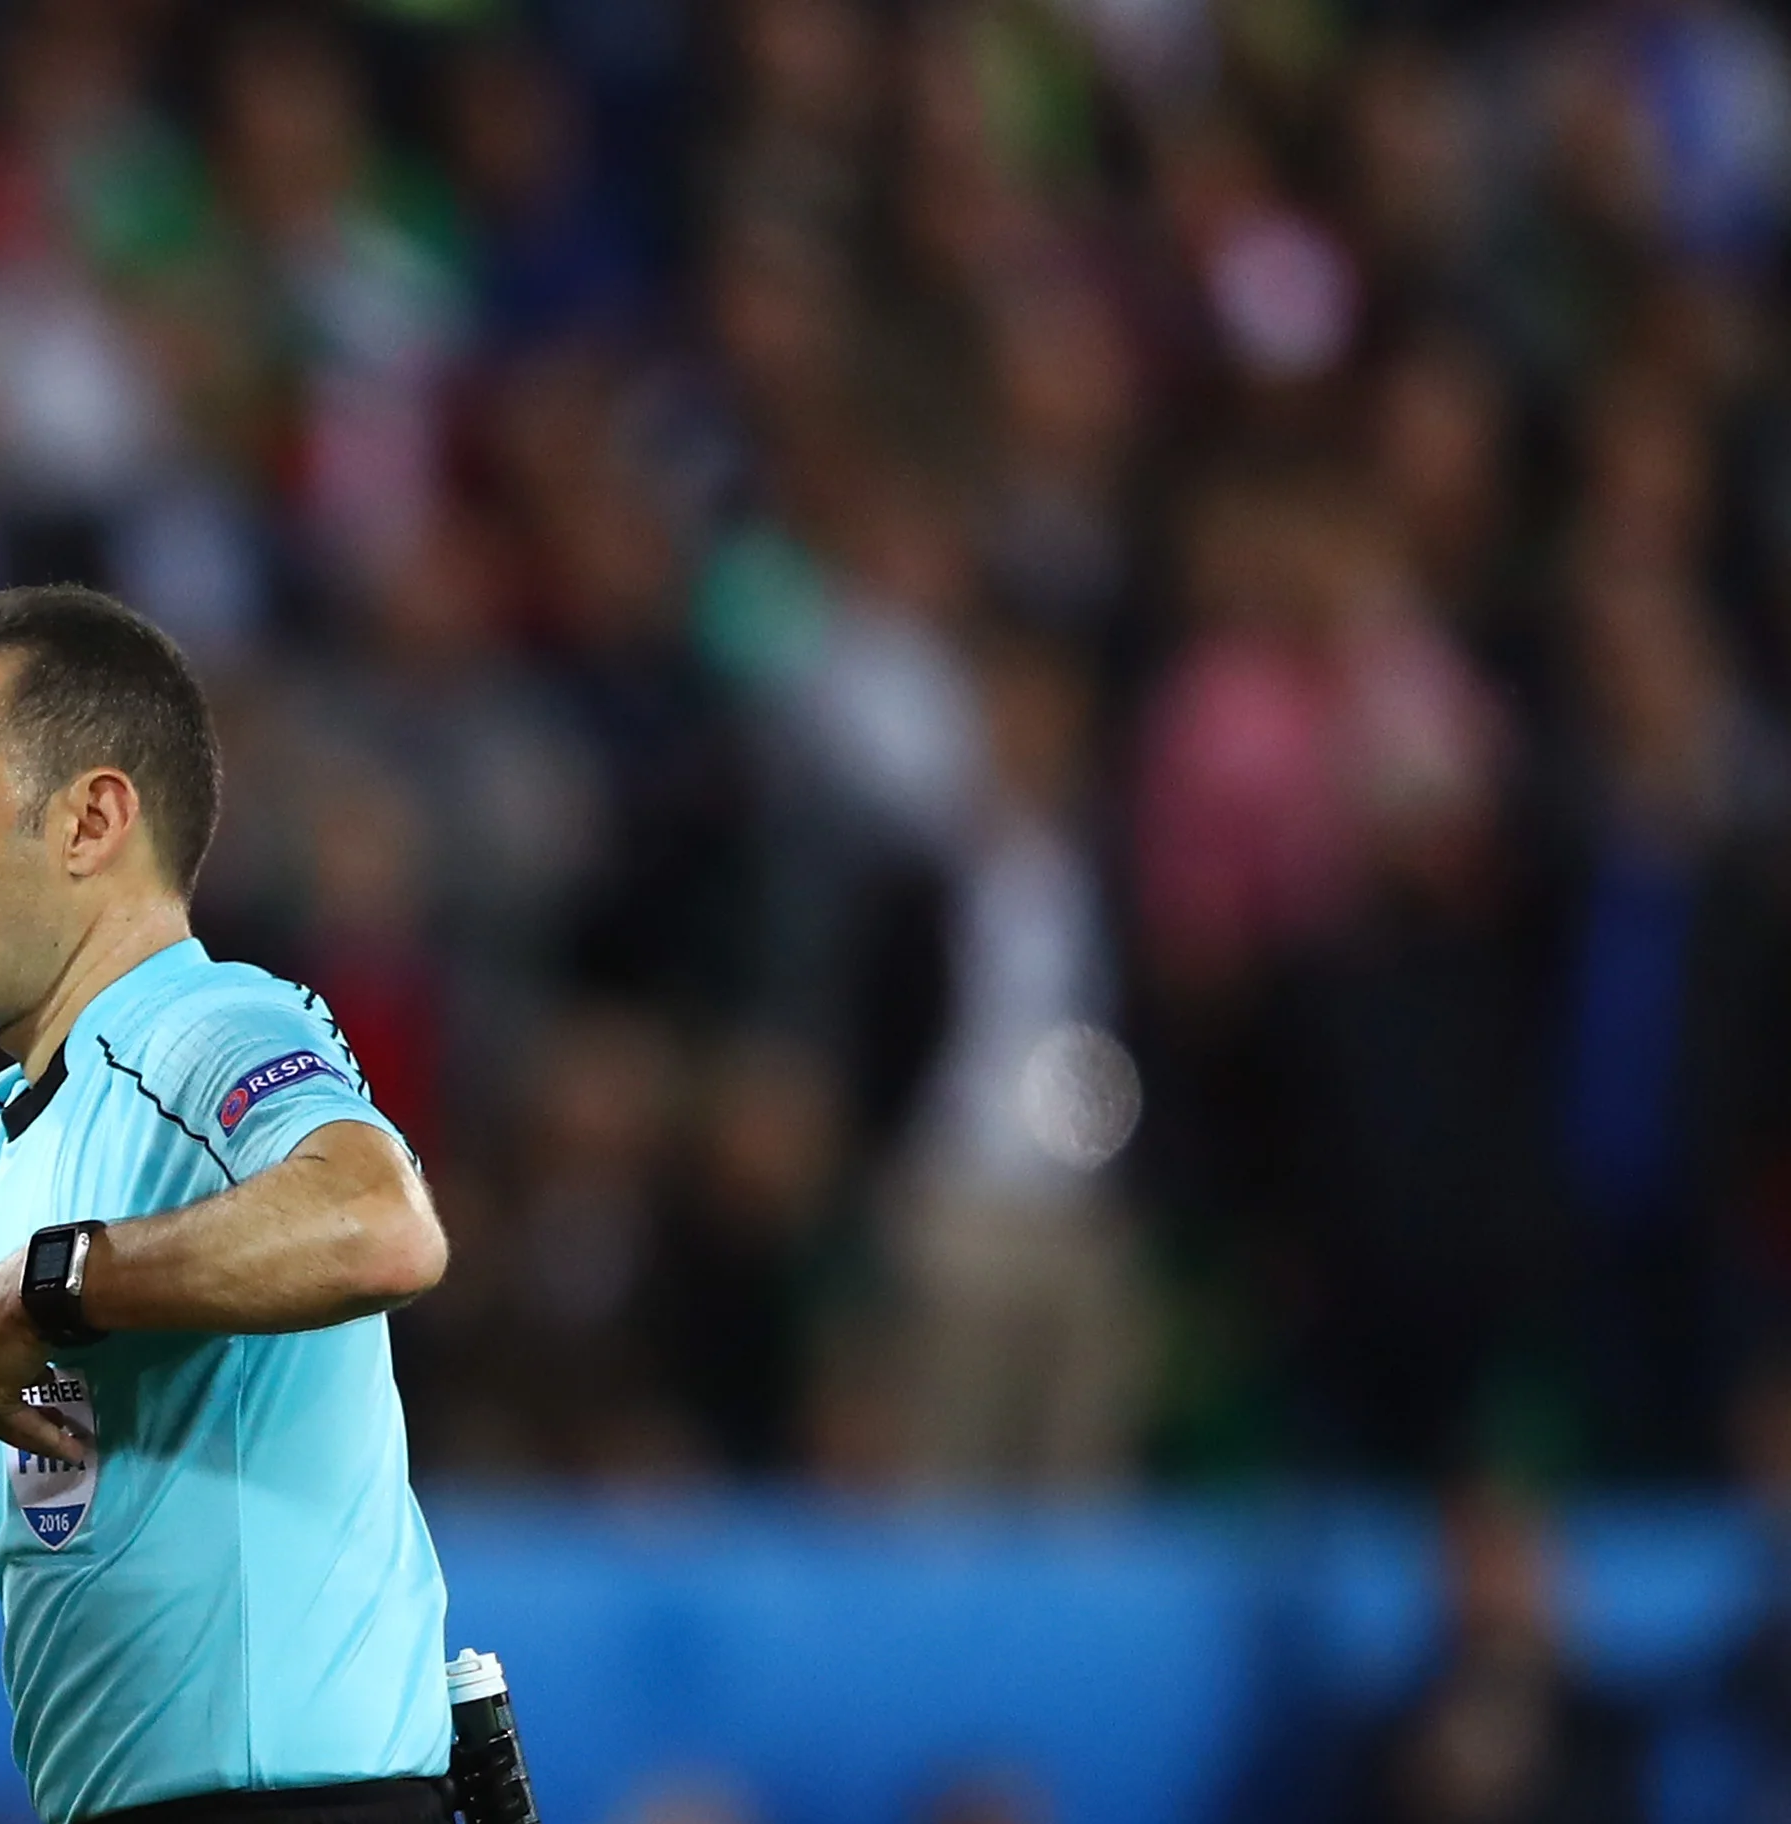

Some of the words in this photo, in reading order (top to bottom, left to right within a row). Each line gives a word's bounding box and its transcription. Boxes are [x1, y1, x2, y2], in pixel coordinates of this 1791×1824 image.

[248, 1055, 332, 1093] RESP
[20, 1381, 84, 1404] EFEREE
[38, 1513, 70, 1533] 2016
